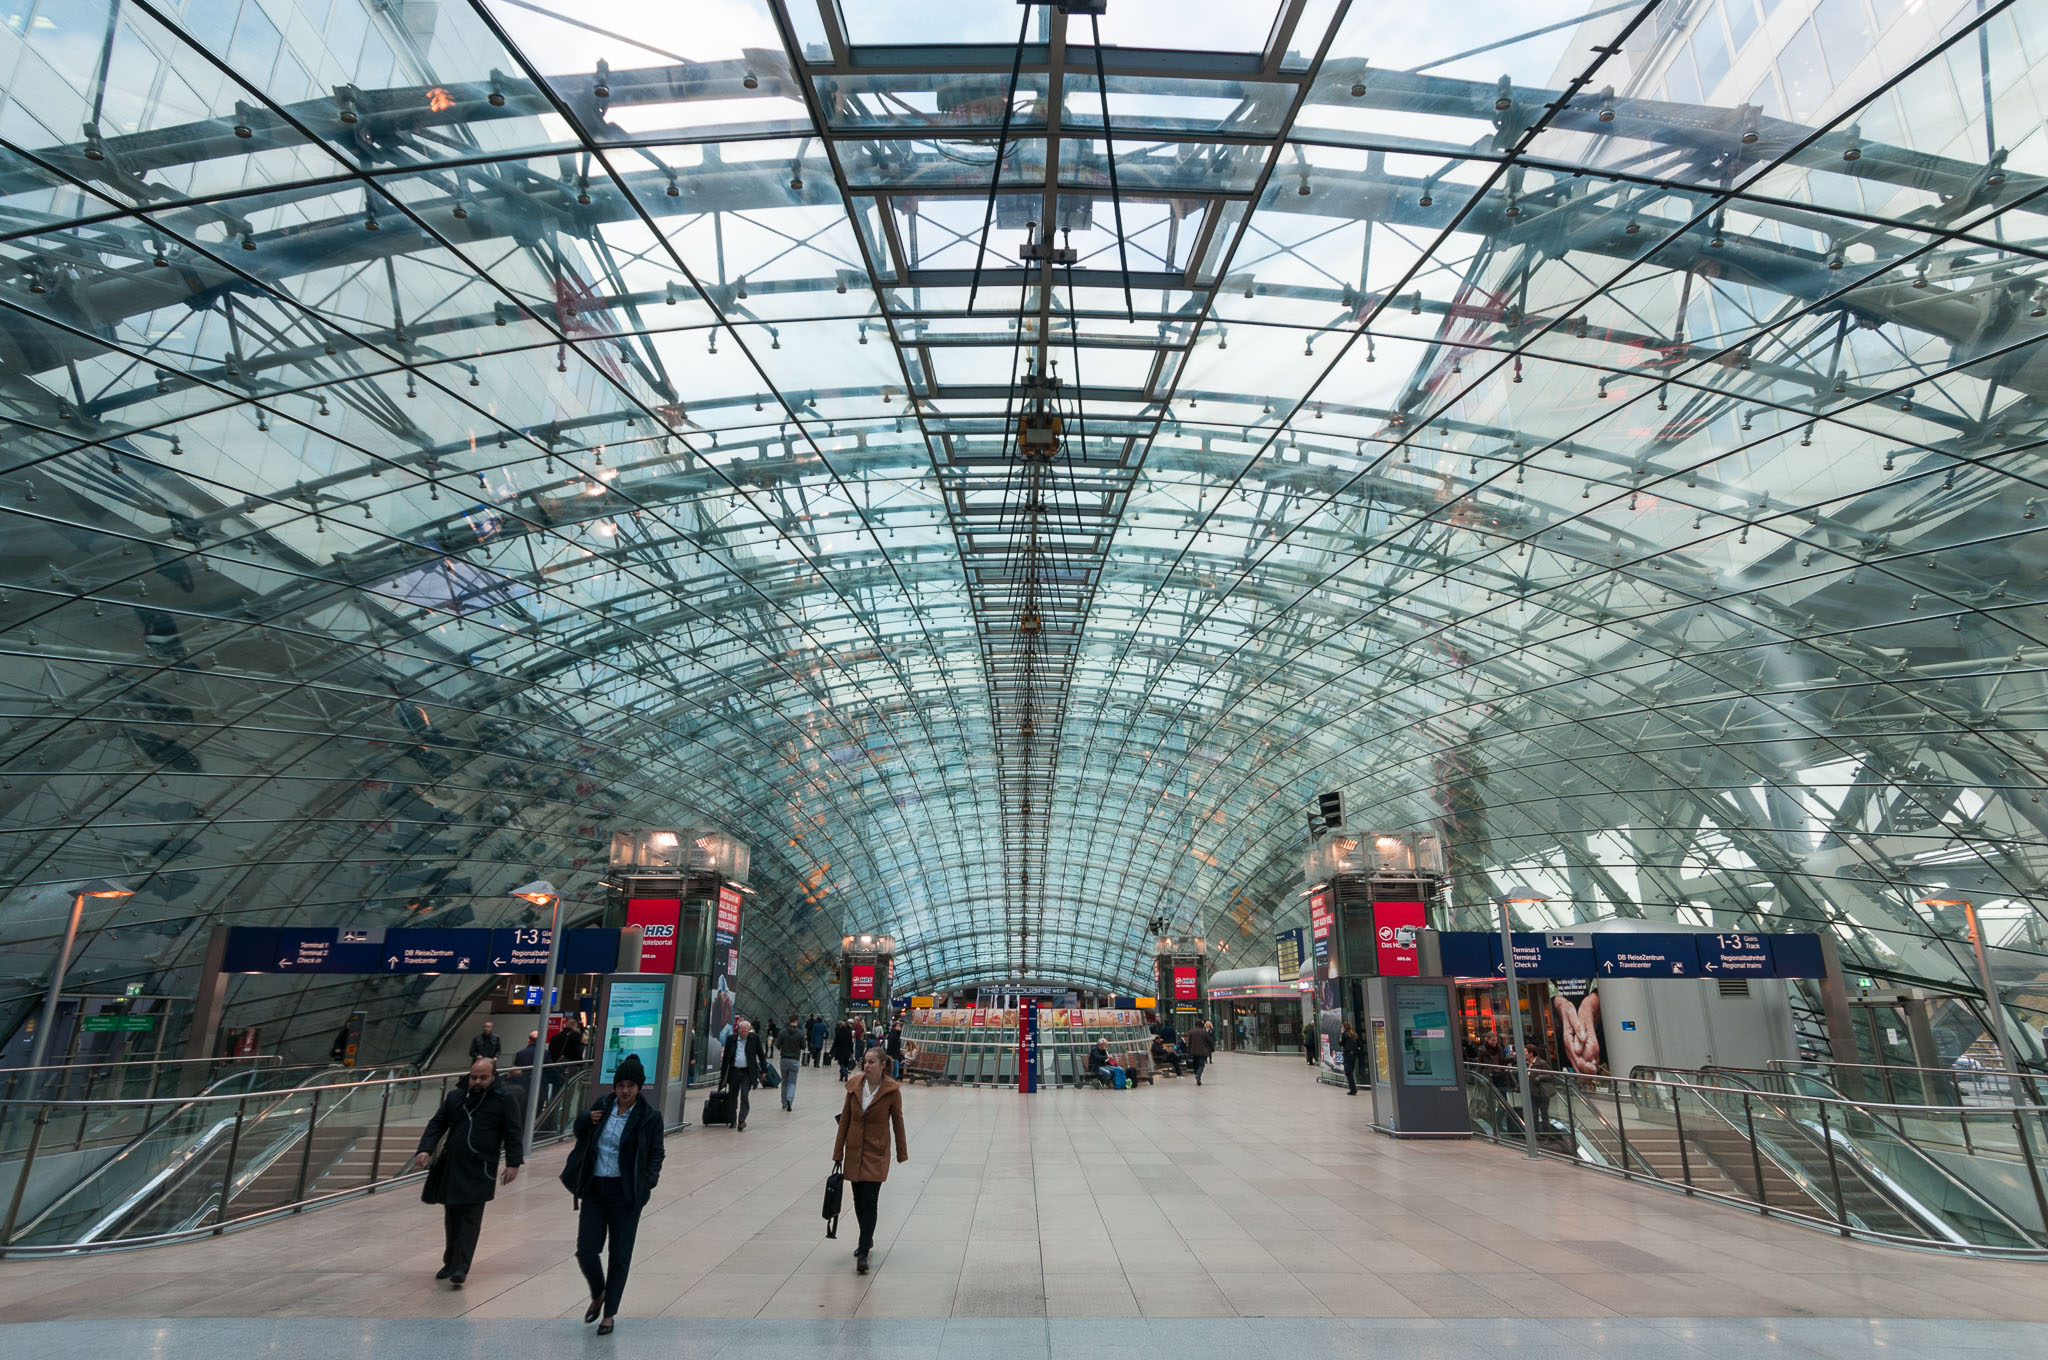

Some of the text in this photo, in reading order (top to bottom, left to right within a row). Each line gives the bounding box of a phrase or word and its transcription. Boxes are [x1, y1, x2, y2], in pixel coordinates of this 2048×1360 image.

[643, 924, 675, 937] HRS
[514, 928, 538, 944] 1-3
[1716, 934, 1742, 949] 1-3
[511, 949, 550, 957] Regionalbahn
[510, 957, 535, 966] Regional
[1720, 954, 1766, 962] Regionalbahnhof
[1722, 962, 1745, 970] Regional
